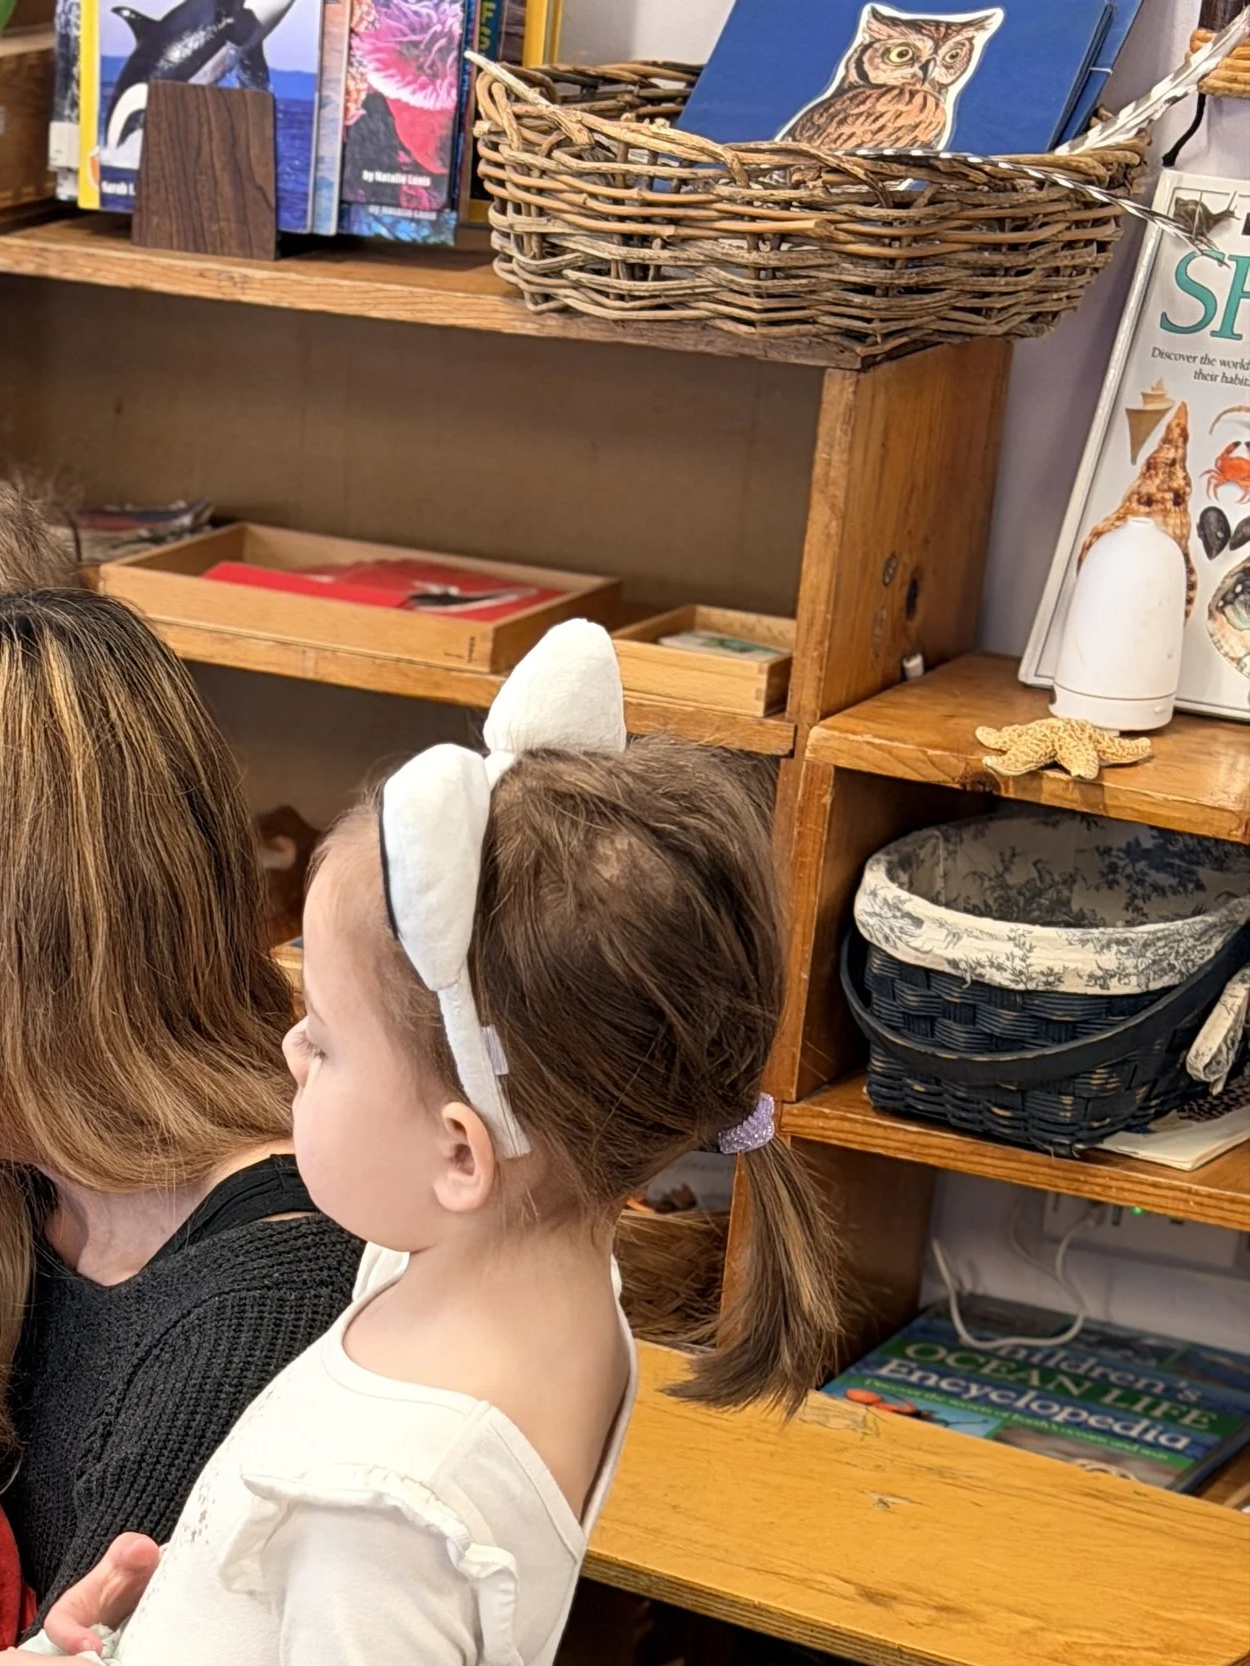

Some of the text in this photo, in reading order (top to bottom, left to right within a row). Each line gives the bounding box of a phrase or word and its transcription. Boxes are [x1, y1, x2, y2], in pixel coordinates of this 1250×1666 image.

[1151, 347, 1198, 364] Discover
[1200, 354, 1217, 367] the
[1194, 368, 1219, 382] their
[905, 1343, 1218, 1431] OCEAN LIFE
[996, 1343, 1202, 1402] ildren's
[876, 1358, 1192, 1451] Encyclopedia
